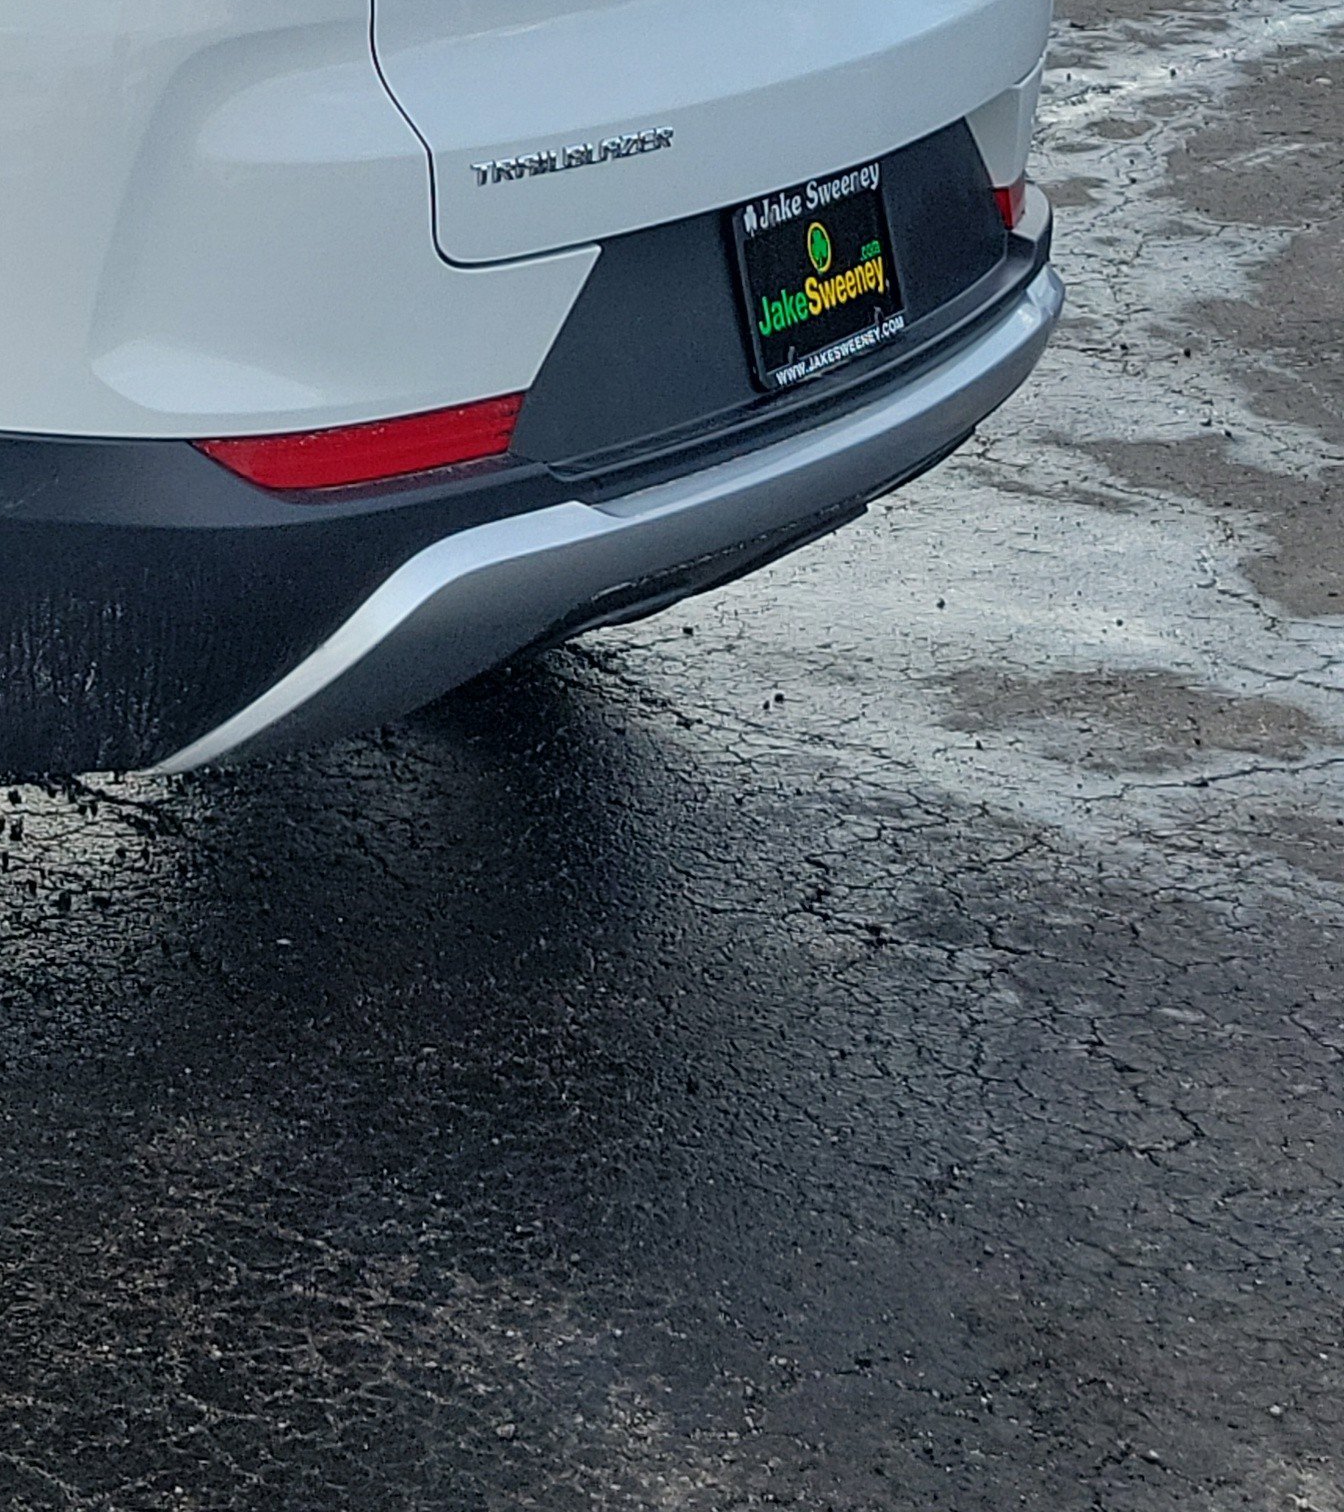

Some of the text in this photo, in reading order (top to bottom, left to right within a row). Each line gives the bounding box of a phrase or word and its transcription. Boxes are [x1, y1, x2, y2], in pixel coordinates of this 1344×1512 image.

[470, 126, 674, 186] TRAILBLAZER
[760, 162, 880, 230] Jake Sweeney
[775, 315, 905, 386] WWW.JAKESWEENEY.COM
